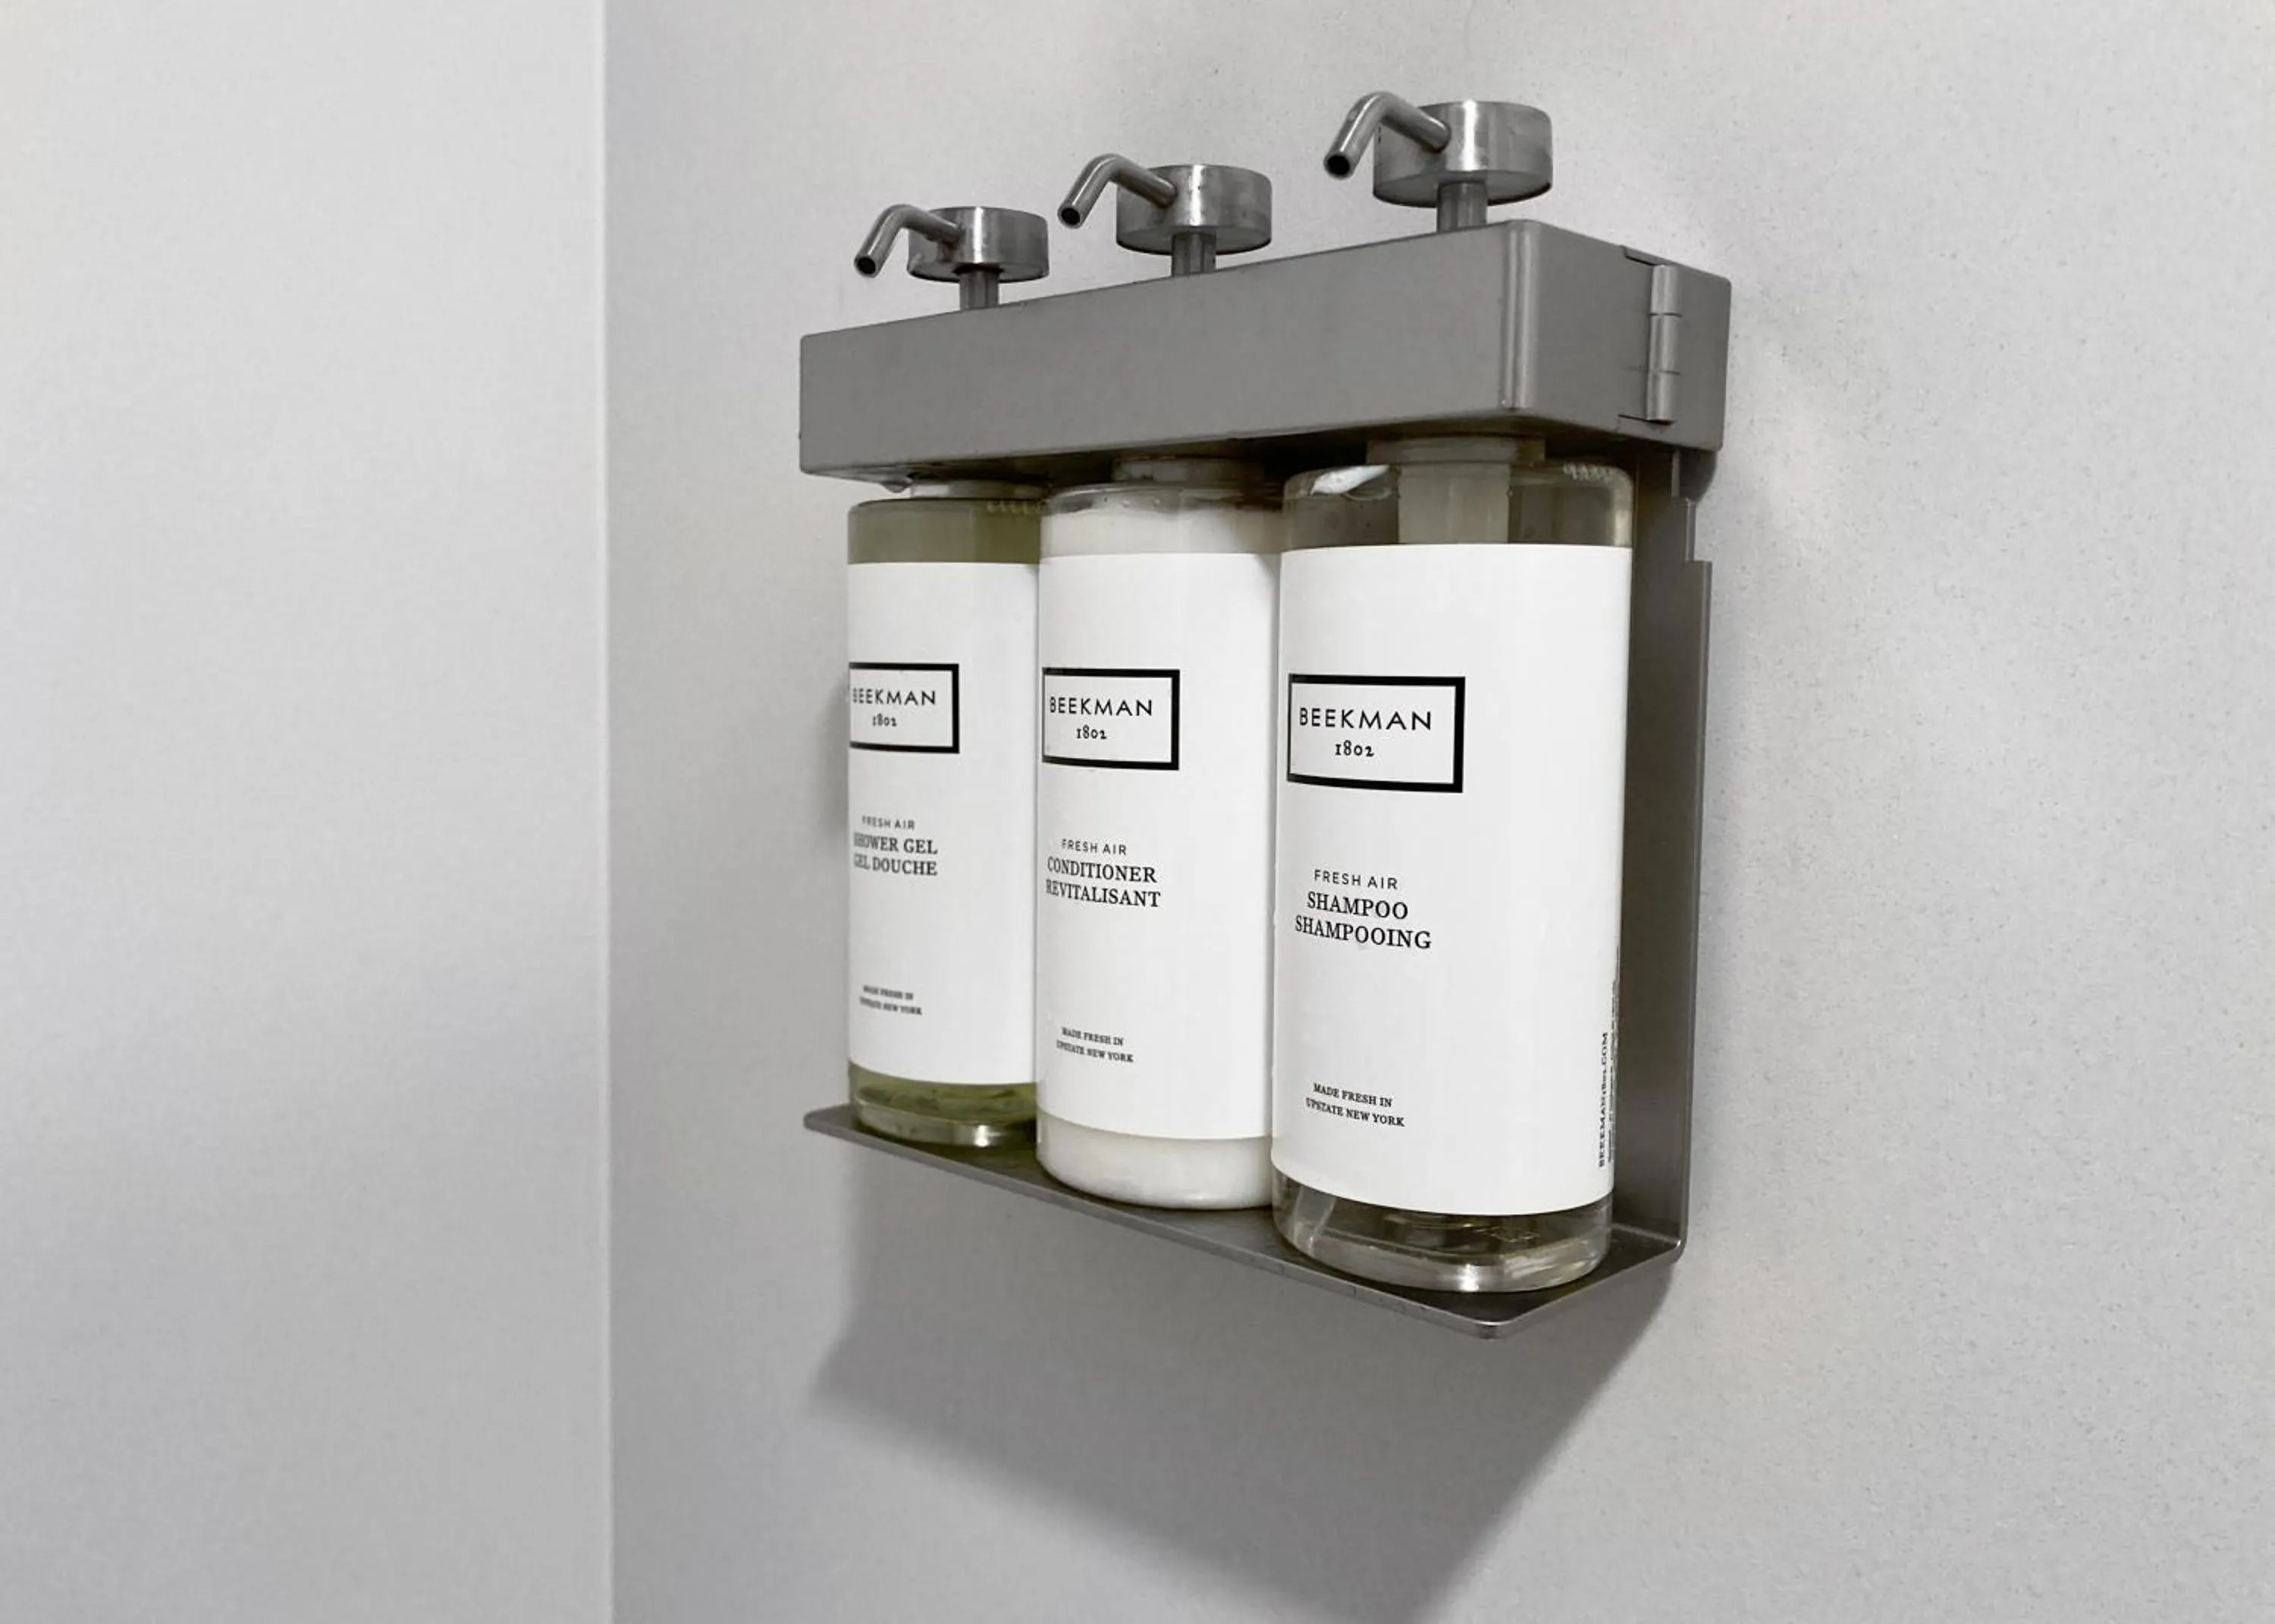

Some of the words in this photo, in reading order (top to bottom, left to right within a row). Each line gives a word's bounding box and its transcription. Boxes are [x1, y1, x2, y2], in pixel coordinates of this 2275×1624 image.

[1050, 697, 1152, 716] BEEKMAN
[873, 713, 897, 727] 1802
[1300, 707, 1431, 731] BEEKMAN
[1077, 725, 1107, 739] 1802
[1335, 740, 1374, 757] 1802
[862, 816, 891, 828] FRESH
[895, 820, 915, 830] AIR
[904, 839, 937, 854] GEL
[1062, 839, 1098, 854] FRESH
[1102, 844, 1126, 856] AIR
[873, 857, 937, 876] DOUCHE
[1046, 857, 1157, 883] CONDITIONER
[1314, 870, 1361, 886] FRESH
[1367, 876, 1398, 890] AIR
[1046, 879, 1161, 907] REVITALISANT
[1307, 892, 1407, 920] SHAMPOO
[1295, 915, 1432, 949] SHAMPOOING
[1083, 1032, 1111, 1045] FRESH
[1113, 1037, 1124, 1046] IN
[1086, 1048, 1106, 1058] NEW
[1107, 1052, 1134, 1063] YORK
[1313, 1083, 1339, 1099] MADE
[1341, 1089, 1376, 1105] FRESH
[1379, 1097, 1392, 1107] IN
[1306, 1097, 1344, 1116] UPSTATE
[1346, 1108, 1370, 1121] NEW
[1372, 1113, 1404, 1127] YORK
